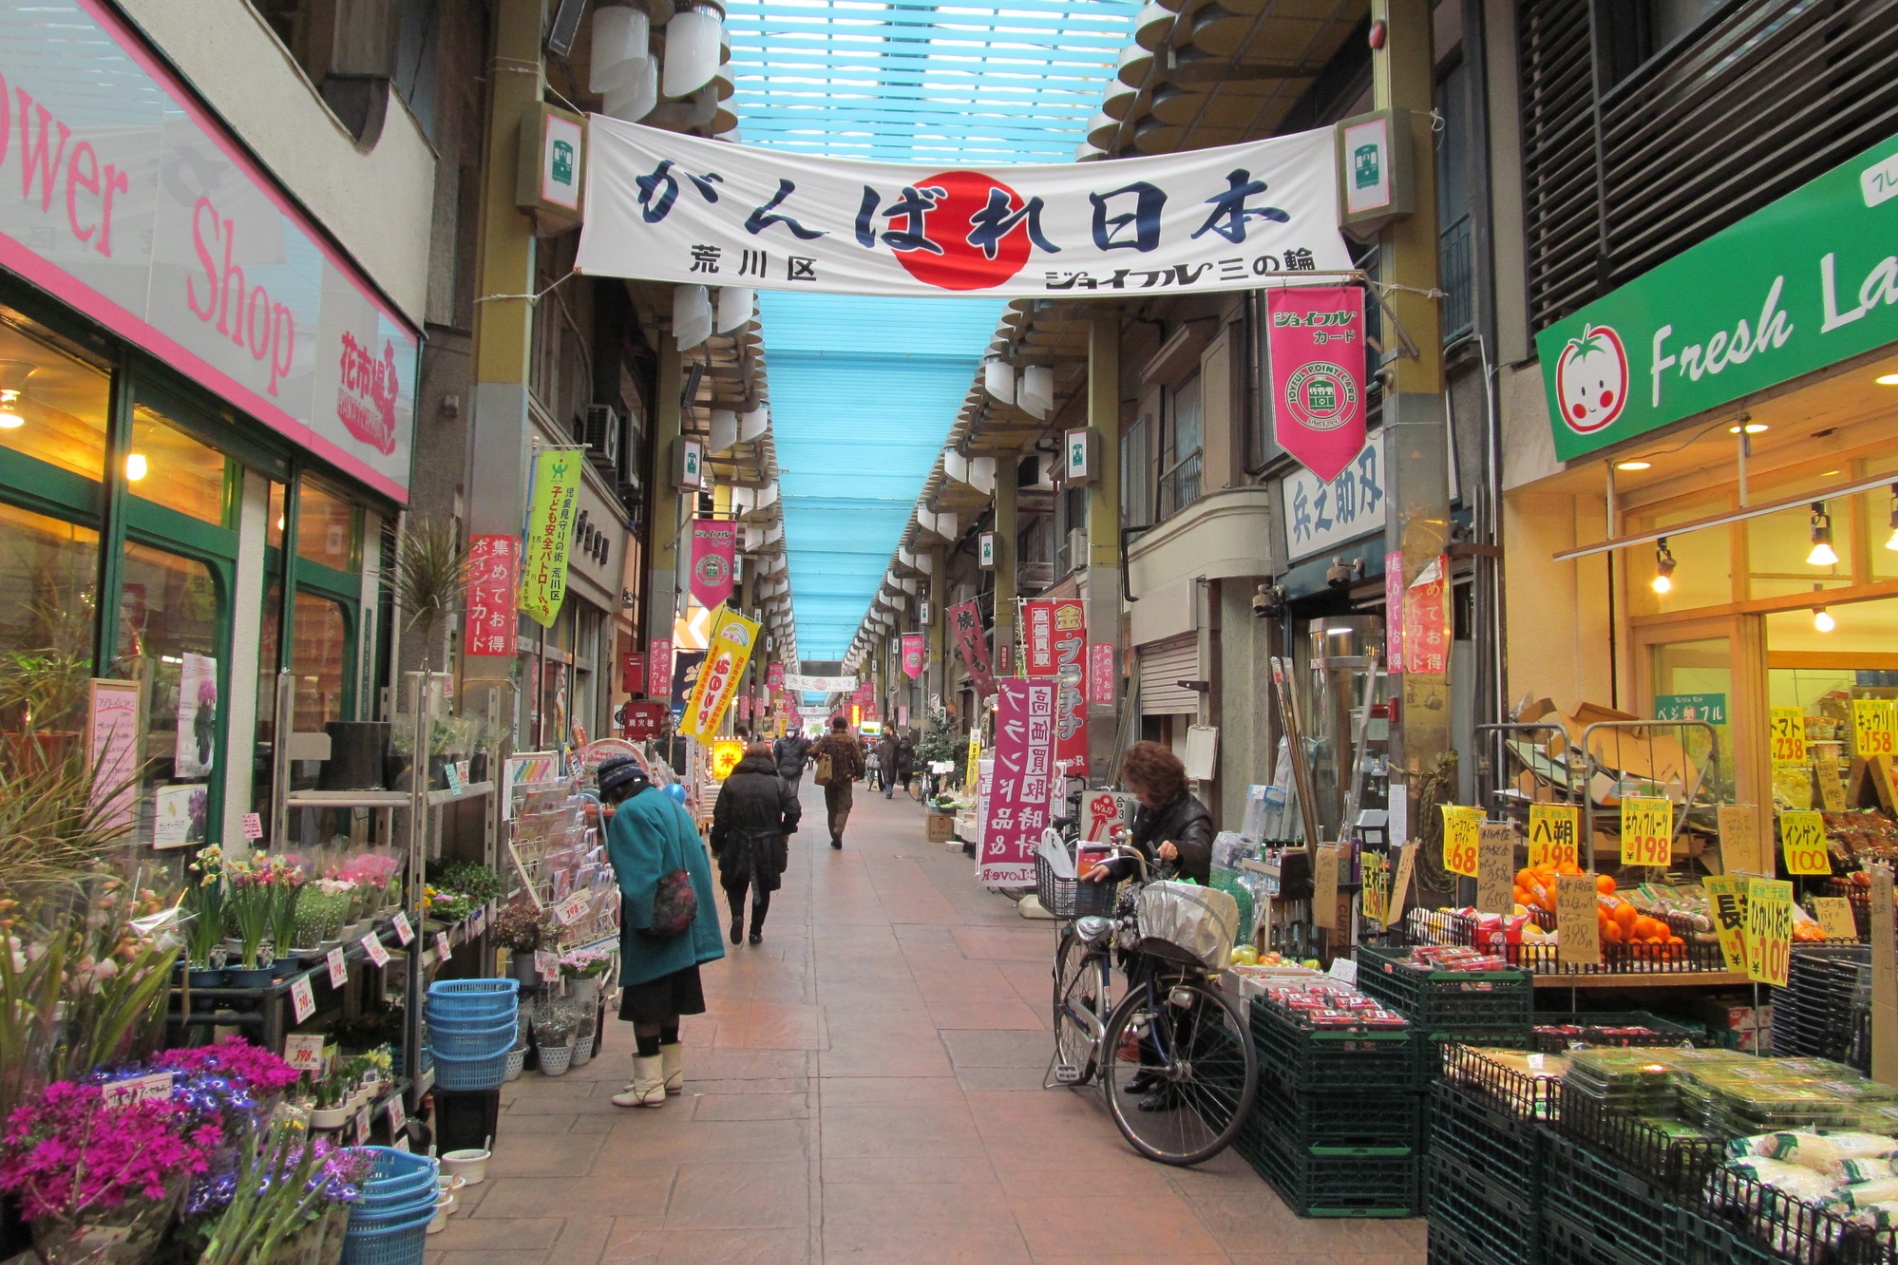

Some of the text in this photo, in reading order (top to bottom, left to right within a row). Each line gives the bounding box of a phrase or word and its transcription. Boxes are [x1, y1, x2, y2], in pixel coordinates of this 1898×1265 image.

[634, 159, 1291, 255] がんばれ日本
[689, 244, 817, 281] 荒川区
[187, 197, 294, 396] Shop
[1273, 310, 1357, 327] ジョイフル
[1313, 330, 1357, 344] カード
[1651, 275, 1793, 408] Fresh
[1288, 364, 1355, 403] JOYFUL POINT CARD
[471, 537, 490, 652] ポイントカード
[488, 539, 509, 653] 集めてお得
[551, 567, 562, 601] 荒川区
[956, 610, 988, 673] 焼いも
[1426, 582, 1442, 670] めてお得
[1093, 802, 1114, 815] W&S
[1533, 819, 1574, 846] 八朔
[1786, 825, 1821, 845] インゲン
[294, 1049, 313, 1062] 398
